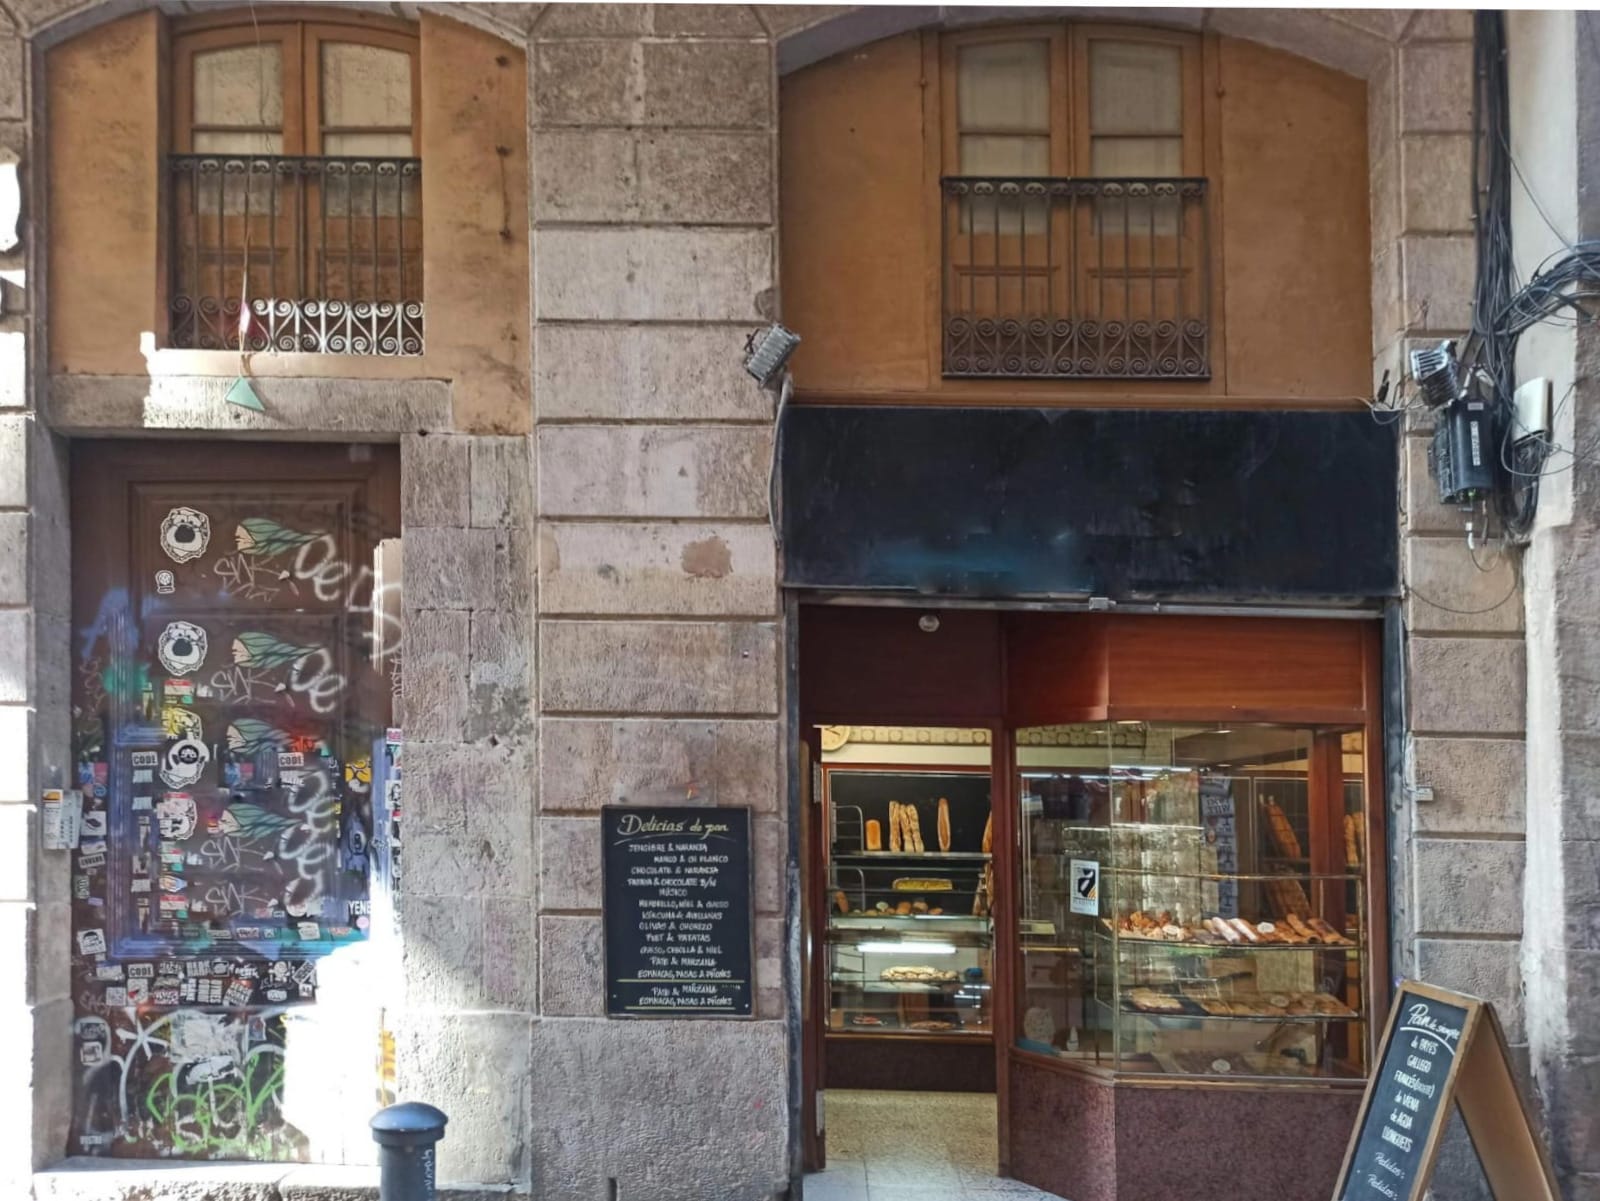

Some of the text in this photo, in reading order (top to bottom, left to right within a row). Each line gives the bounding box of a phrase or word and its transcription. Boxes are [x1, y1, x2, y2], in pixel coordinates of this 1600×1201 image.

[616, 814, 729, 840] Delicias de pan
[675, 844, 708, 853] NARANJA
[1408, 1003, 1431, 1027] Pan
[1375, 1151, 1406, 1180] Pedidos:
